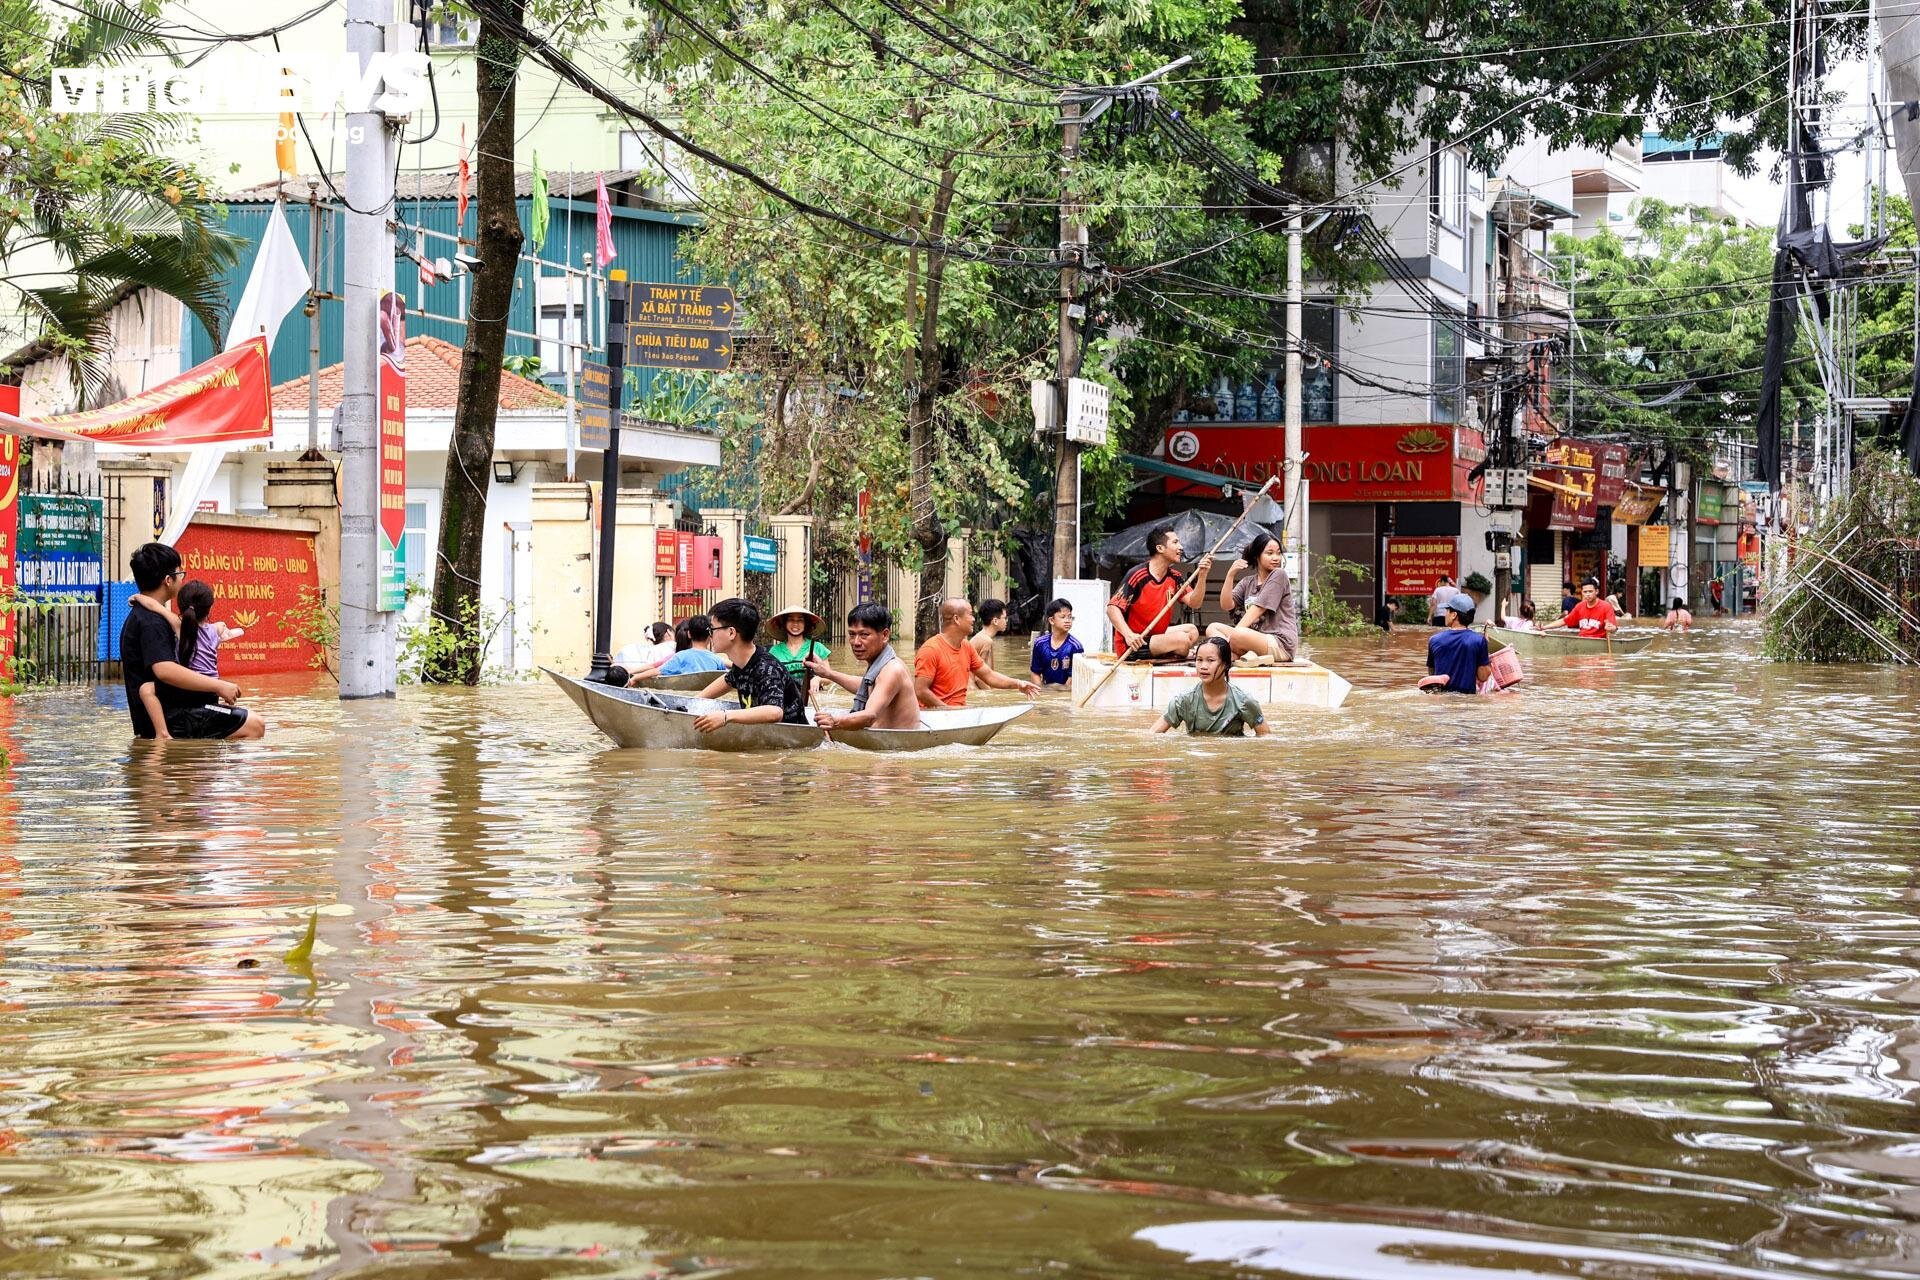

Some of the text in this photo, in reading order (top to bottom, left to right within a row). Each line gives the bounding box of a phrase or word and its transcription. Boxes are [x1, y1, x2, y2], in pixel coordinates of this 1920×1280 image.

[650, 287, 703, 302] TRẠM Y TẾ
[641, 300, 713, 317] XÃ BÁT TRÀNG
[639, 313, 652, 321] Bat
[653, 314, 673, 324] Trang
[635, 332, 710, 350] CHÙA TIÊU DAO
[1359, 460, 1423, 482] LOAN
[188, 547, 202, 570] SỞ
[203, 548, 230, 571] ĐẢNG
[232, 550, 245, 572] UỶ
[253, 556, 278, 573] HĐND
[284, 558, 308, 574] UBND
[56, 557, 66, 586] XÃ
[66, 556, 79, 586] BÁT
[79, 556, 100, 586] TRÀNG
[213, 580, 275, 600] XÃ BÁT TRÀNG
